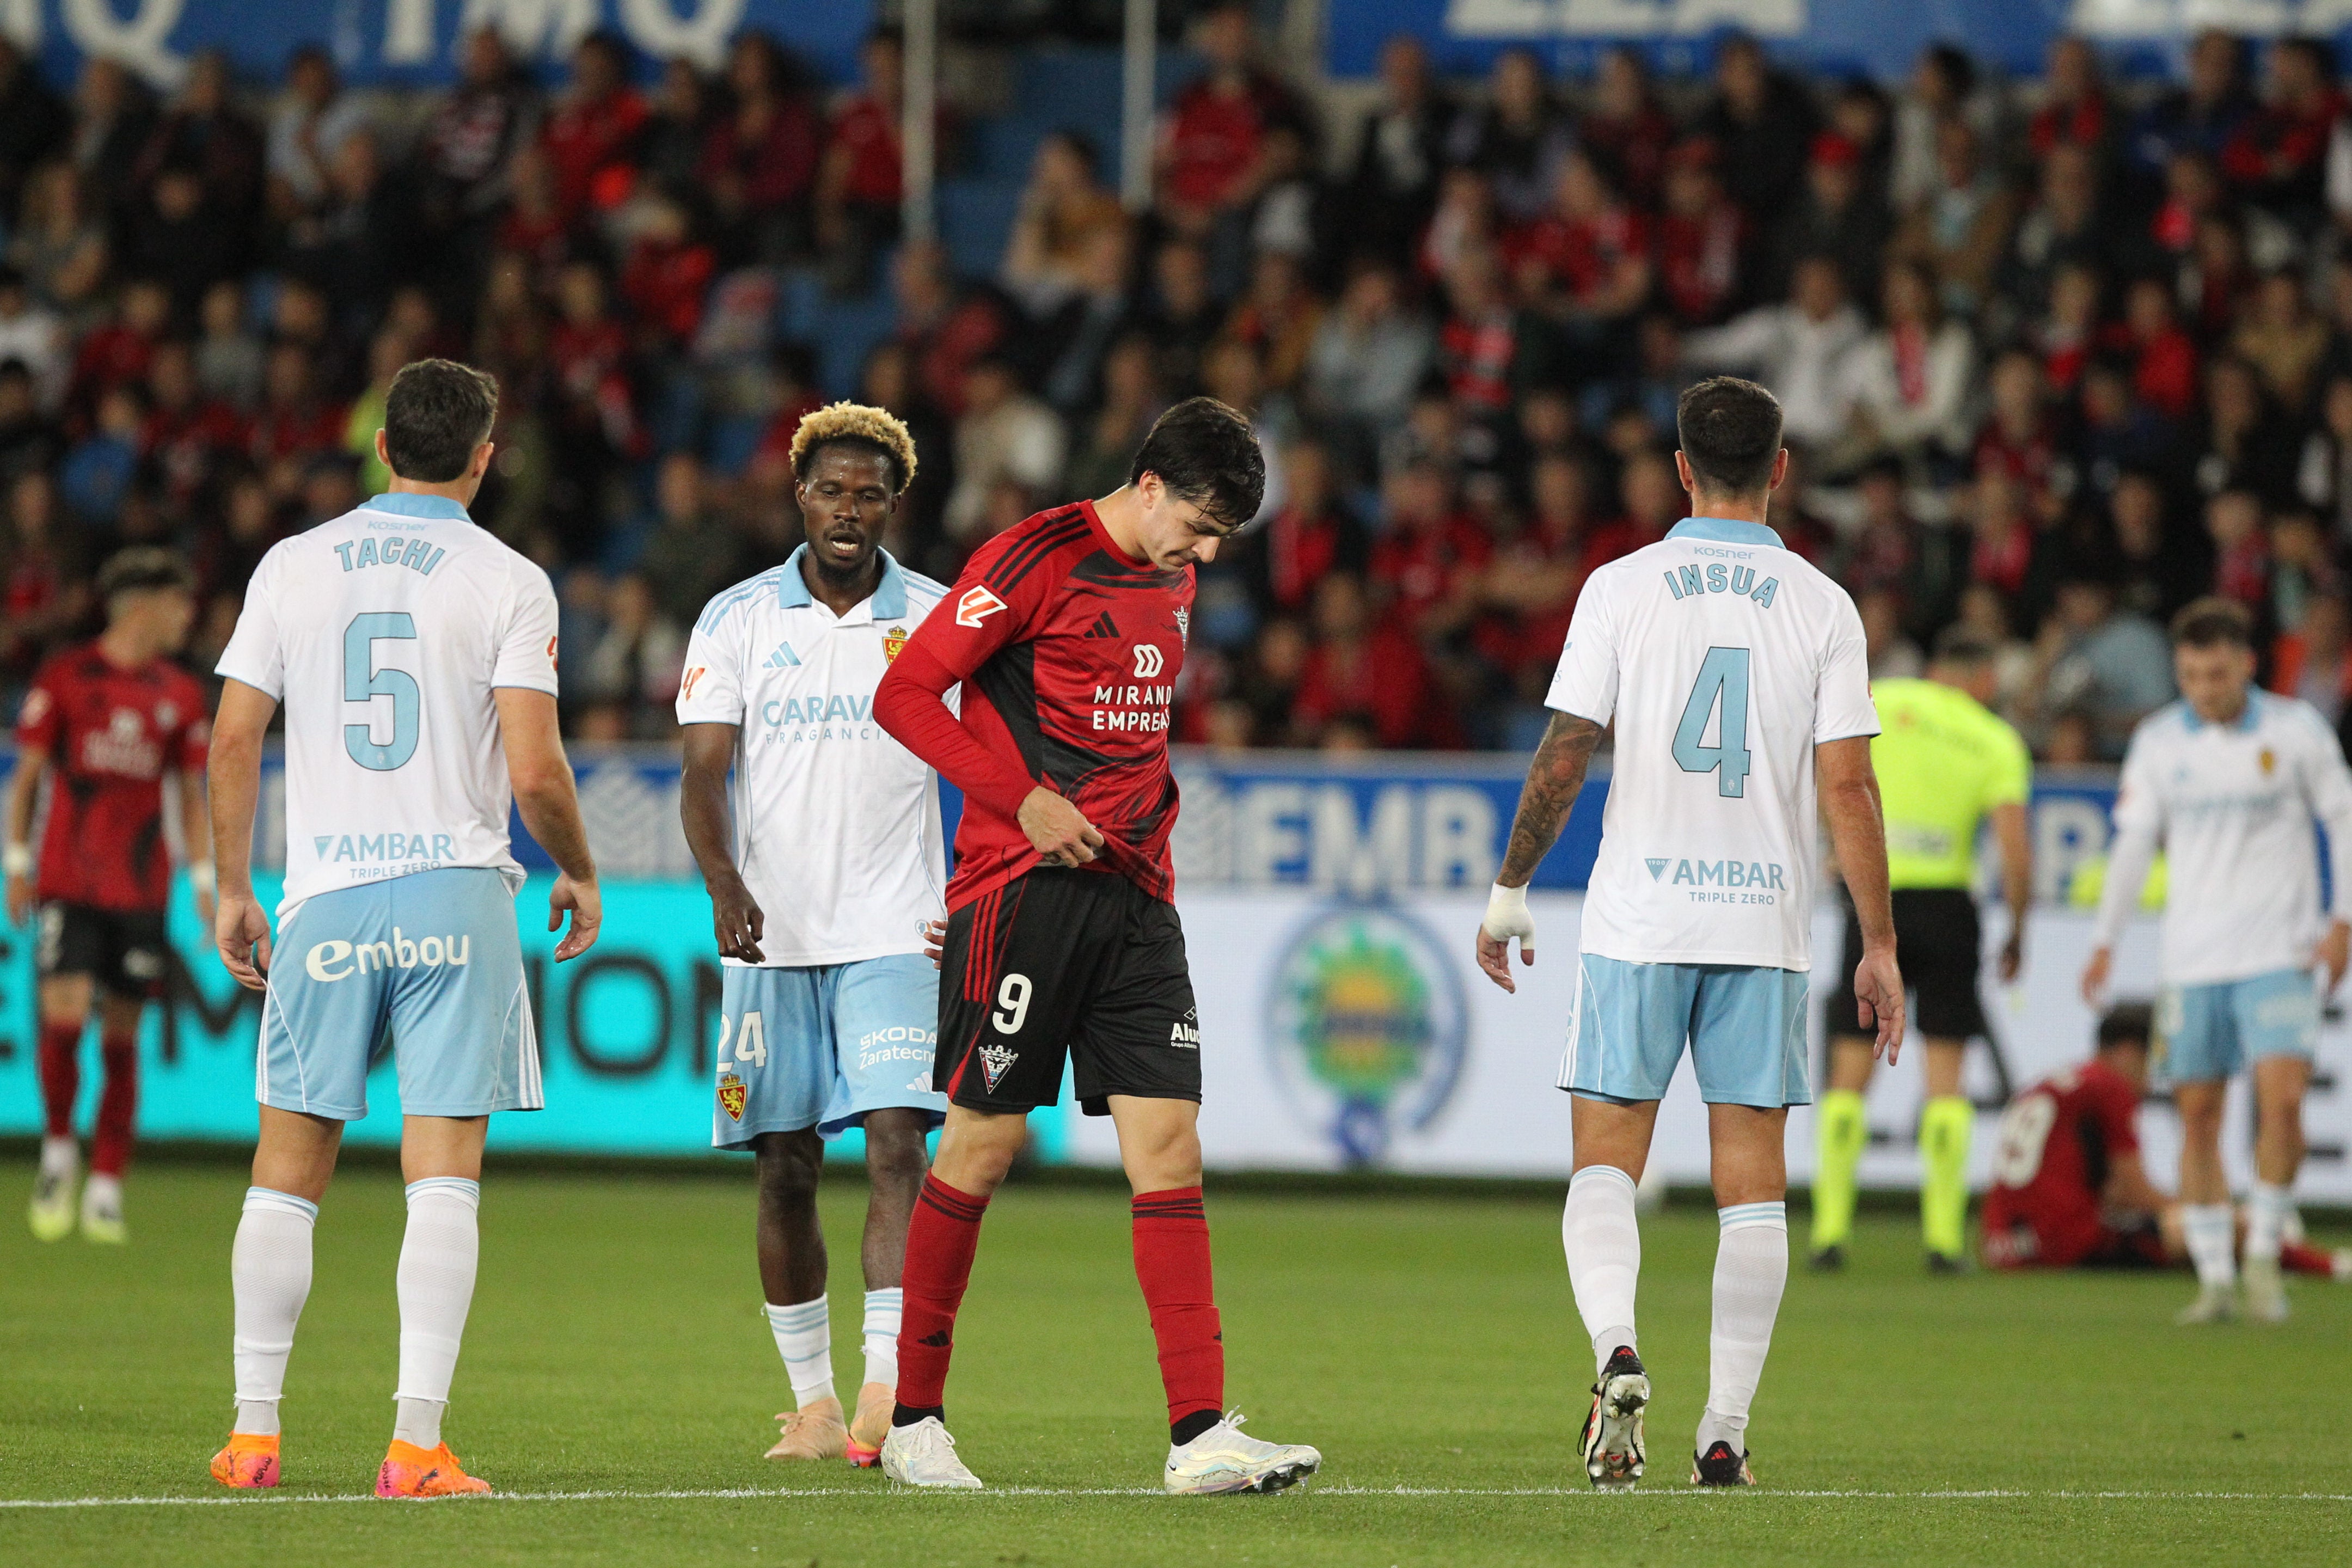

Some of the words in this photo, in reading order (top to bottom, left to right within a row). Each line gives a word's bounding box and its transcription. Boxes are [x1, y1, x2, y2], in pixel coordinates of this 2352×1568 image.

[334, 537, 445, 575] TACHI
[1664, 564, 1779, 609] INSUA
[344, 612, 419, 771] 5
[762, 695, 874, 727] CARAV
[1671, 646, 1751, 798] 4
[333, 833, 456, 862] AMBAR
[350, 866, 396, 878] TRIPLE
[402, 860, 441, 875] ZERO
[1672, 859, 1786, 891] AMBAR
[1689, 892, 1736, 903] TRIPLE
[1741, 893, 1774, 905] ZERO
[305, 926, 469, 982] embou
[992, 973, 1032, 1034] 9
[716, 1010, 767, 1073] 24
